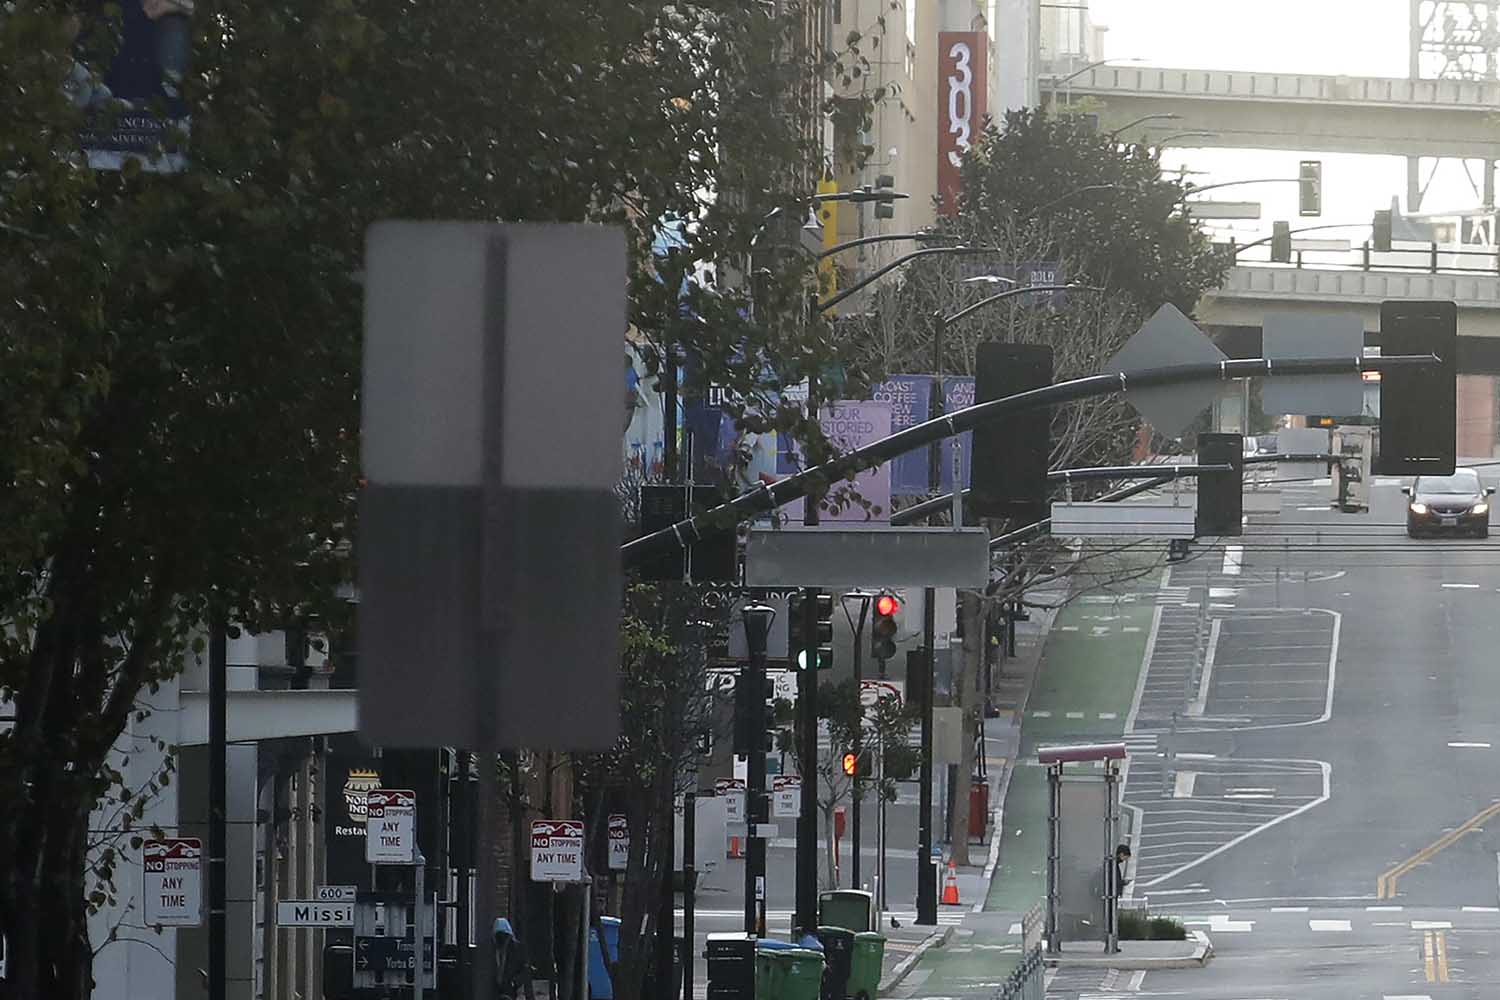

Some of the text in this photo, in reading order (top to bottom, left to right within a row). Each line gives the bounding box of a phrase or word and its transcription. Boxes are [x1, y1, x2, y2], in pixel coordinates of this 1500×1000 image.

[948, 42, 972, 168] 303
[345, 795, 367, 806] NOR
[349, 805, 367, 816] IND
[369, 808, 414, 817] NO STOPPING
[335, 825, 367, 836] Restau
[382, 821, 400, 833] ANY
[380, 836, 401, 847] TIME
[533, 838, 580, 848] NO STOPPING
[536, 853, 577, 864] ANY TIME
[146, 861, 200, 871] NO STOPPING
[162, 877, 184, 889] ANY
[320, 888, 342, 899] 600
[161, 895, 185, 907] TIME
[294, 906, 354, 922] Missi
